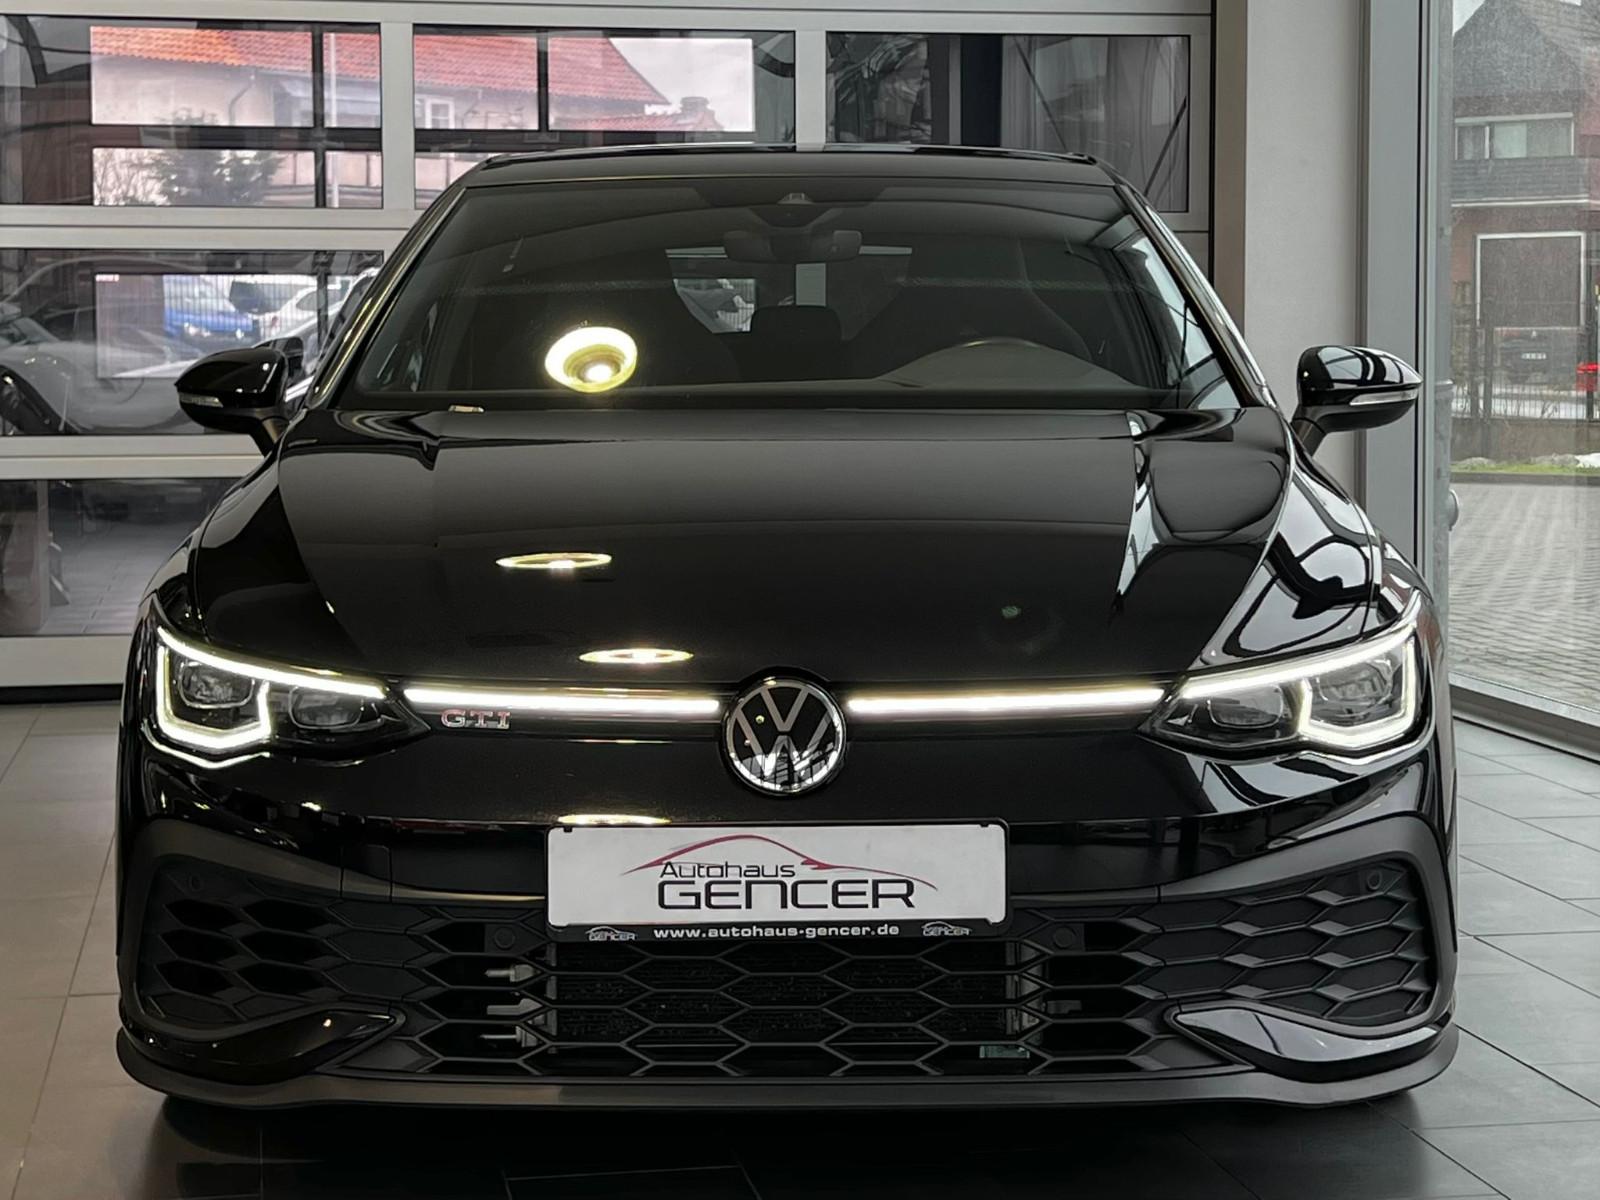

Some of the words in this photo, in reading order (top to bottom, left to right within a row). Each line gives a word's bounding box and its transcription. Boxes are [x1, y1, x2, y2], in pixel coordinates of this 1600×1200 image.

[441, 709, 511, 730] GTI
[659, 861, 796, 878] Autohaus
[658, 879, 915, 910] GENCER
[653, 923, 900, 939] www.autohaus-gencer.de
